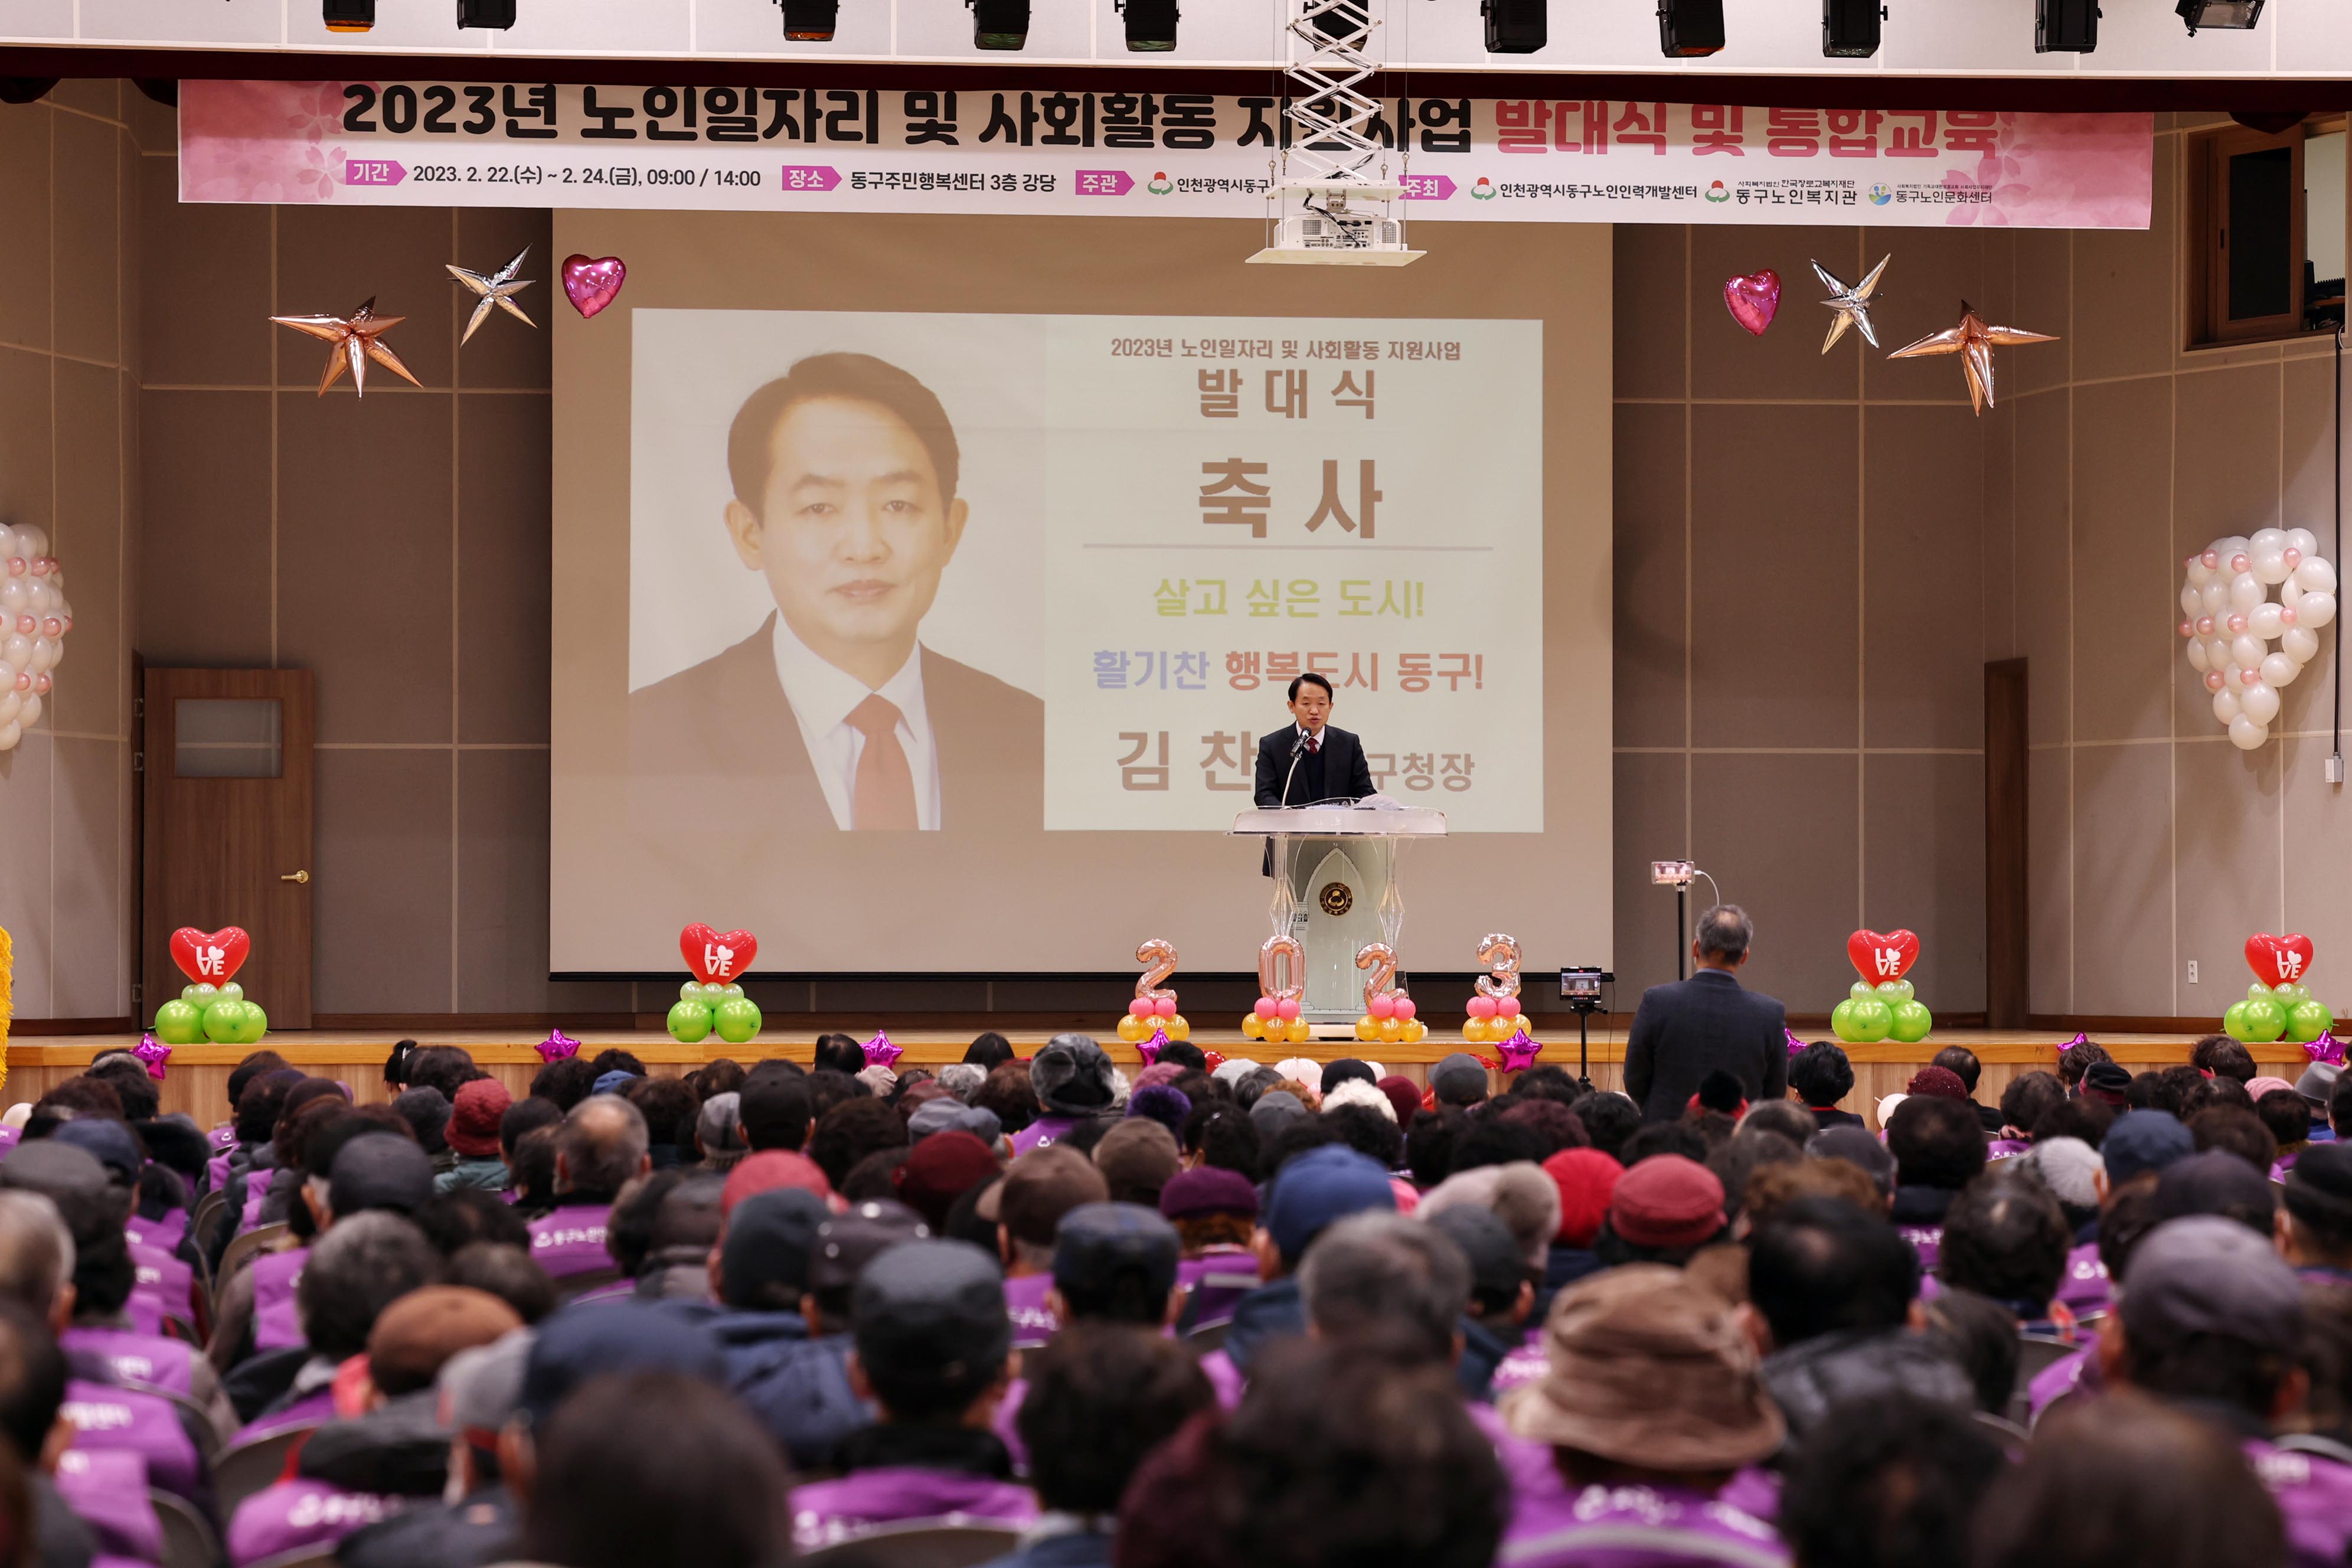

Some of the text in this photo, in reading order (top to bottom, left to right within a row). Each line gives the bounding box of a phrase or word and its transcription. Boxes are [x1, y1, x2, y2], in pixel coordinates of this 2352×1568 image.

[343, 84, 558, 138] 2023년
[580, 86, 878, 144] 노인일자리
[904, 90, 959, 146] 및
[978, 92, 1216, 149] 사회활동
[1496, 100, 1666, 155] 발대식
[1691, 104, 1745, 156] 및
[1766, 106, 1998, 159] 통합교육
[354, 162, 389, 182] 기간
[414, 166, 460, 182] 2023.
[467, 167, 482, 182] 2.
[487, 165, 542, 185] 22.(수)
[562, 168, 577, 183] 2.
[583, 167, 642, 187] 24.(금),
[647, 169, 695, 185] 09:00
[714, 171, 760, 187] 14:00
[789, 169, 824, 189] 장소
[851, 172, 1057, 192] 동구주민행복센터 3층 강당
[1083, 175, 1118, 194] 주관
[1177, 178, 1269, 194] 인천광역시동구
[1407, 179, 1438, 197] 주최
[1500, 183, 1697, 200] 인천광역시동구노인인력개발센터
[1736, 189, 1857, 205] 동구노인복지관
[1896, 190, 1992, 204] 동구노인문화센터
[1111, 338, 1461, 361] 2023년 노인일자리 및 사회활동 지원사업
[1153, 579, 1424, 619] 살고 싶은 도시!
[1093, 650, 1210, 690] 활기찬
[1397, 653, 1483, 693] 동구!
